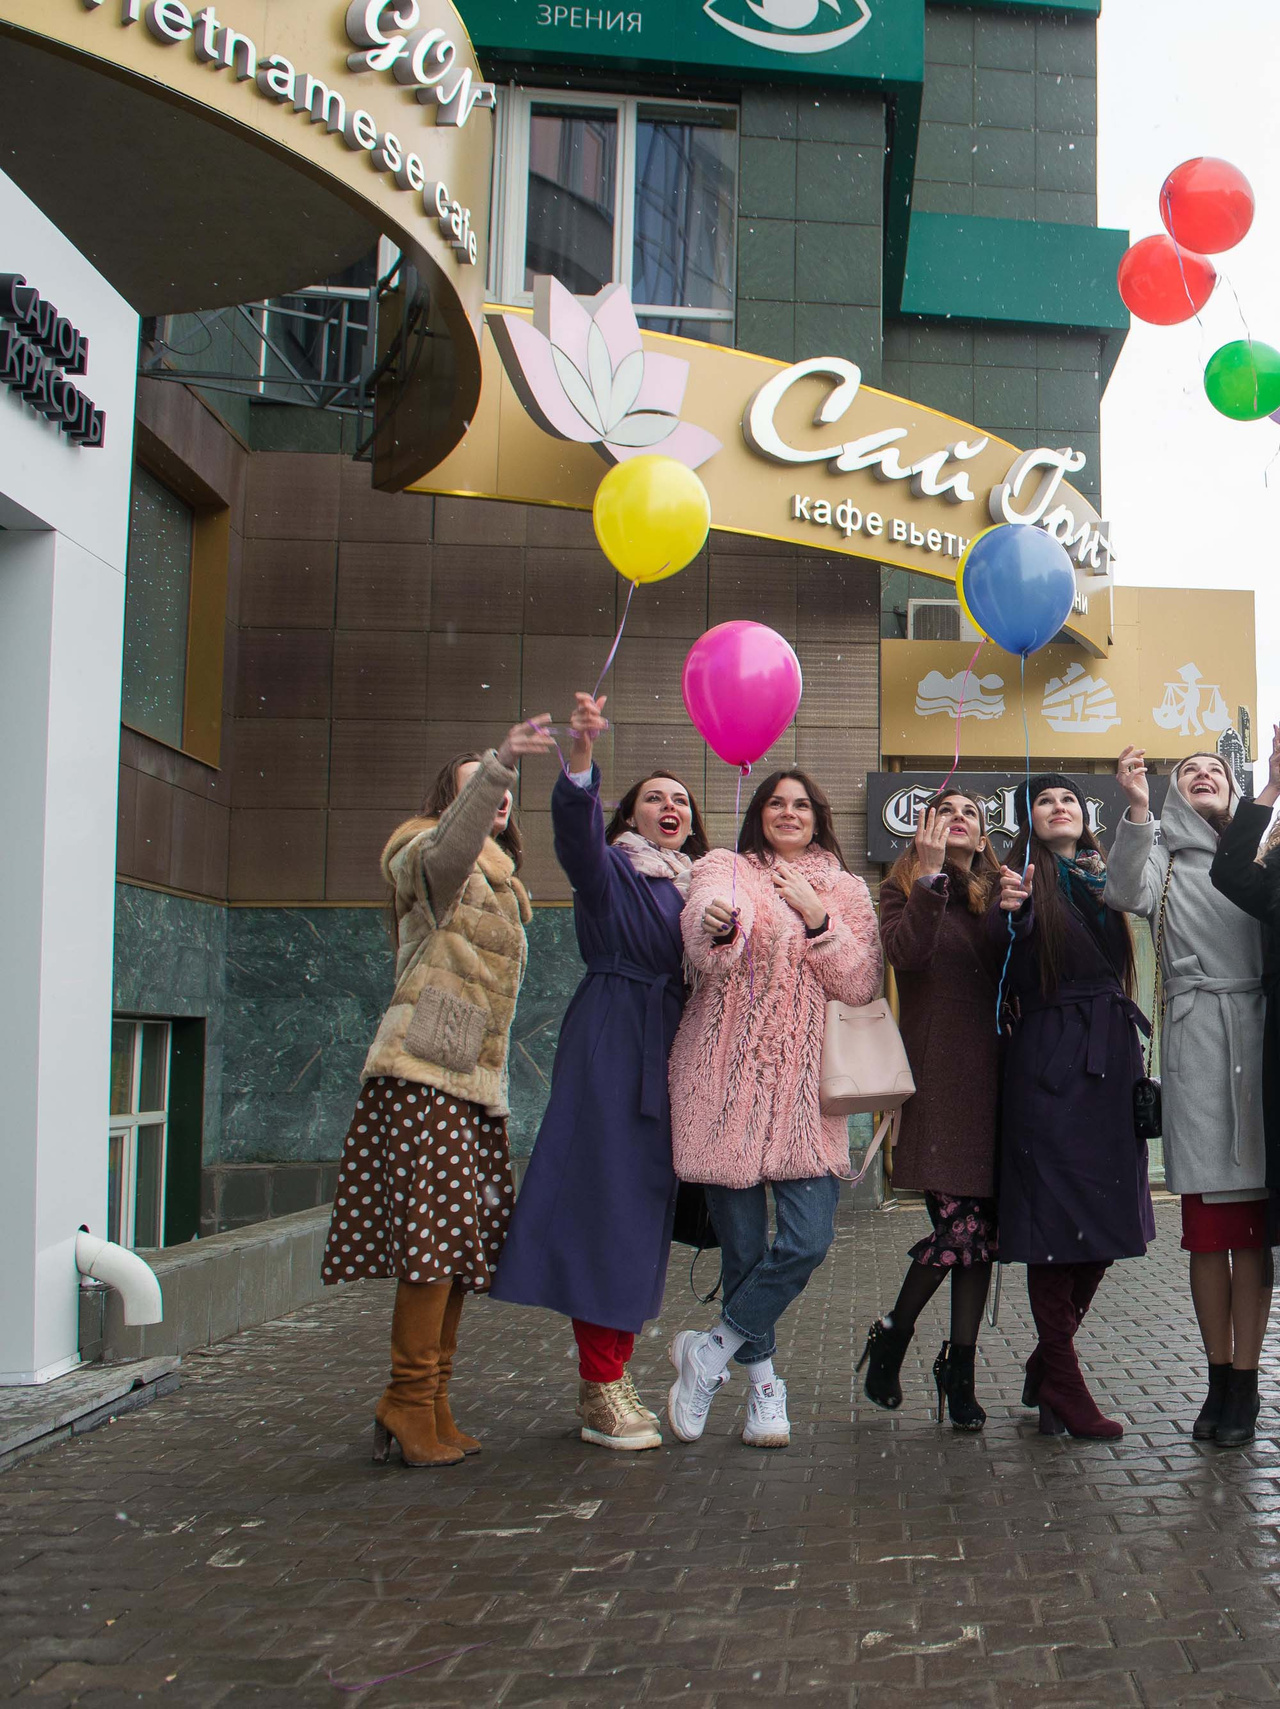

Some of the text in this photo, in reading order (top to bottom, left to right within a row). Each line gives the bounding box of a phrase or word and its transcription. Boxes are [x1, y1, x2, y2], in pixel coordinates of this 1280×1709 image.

[536, 4, 642, 33] ЗРЕНИЯ
[432, 181, 477, 266] cafe
[6, 273, 90, 377] САЛОН
[3, 328, 107, 449] КРАСОТЫ
[749, 356, 989, 502] Сай
[794, 494, 884, 537] кафе
[891, 517, 971, 559] вьетн
